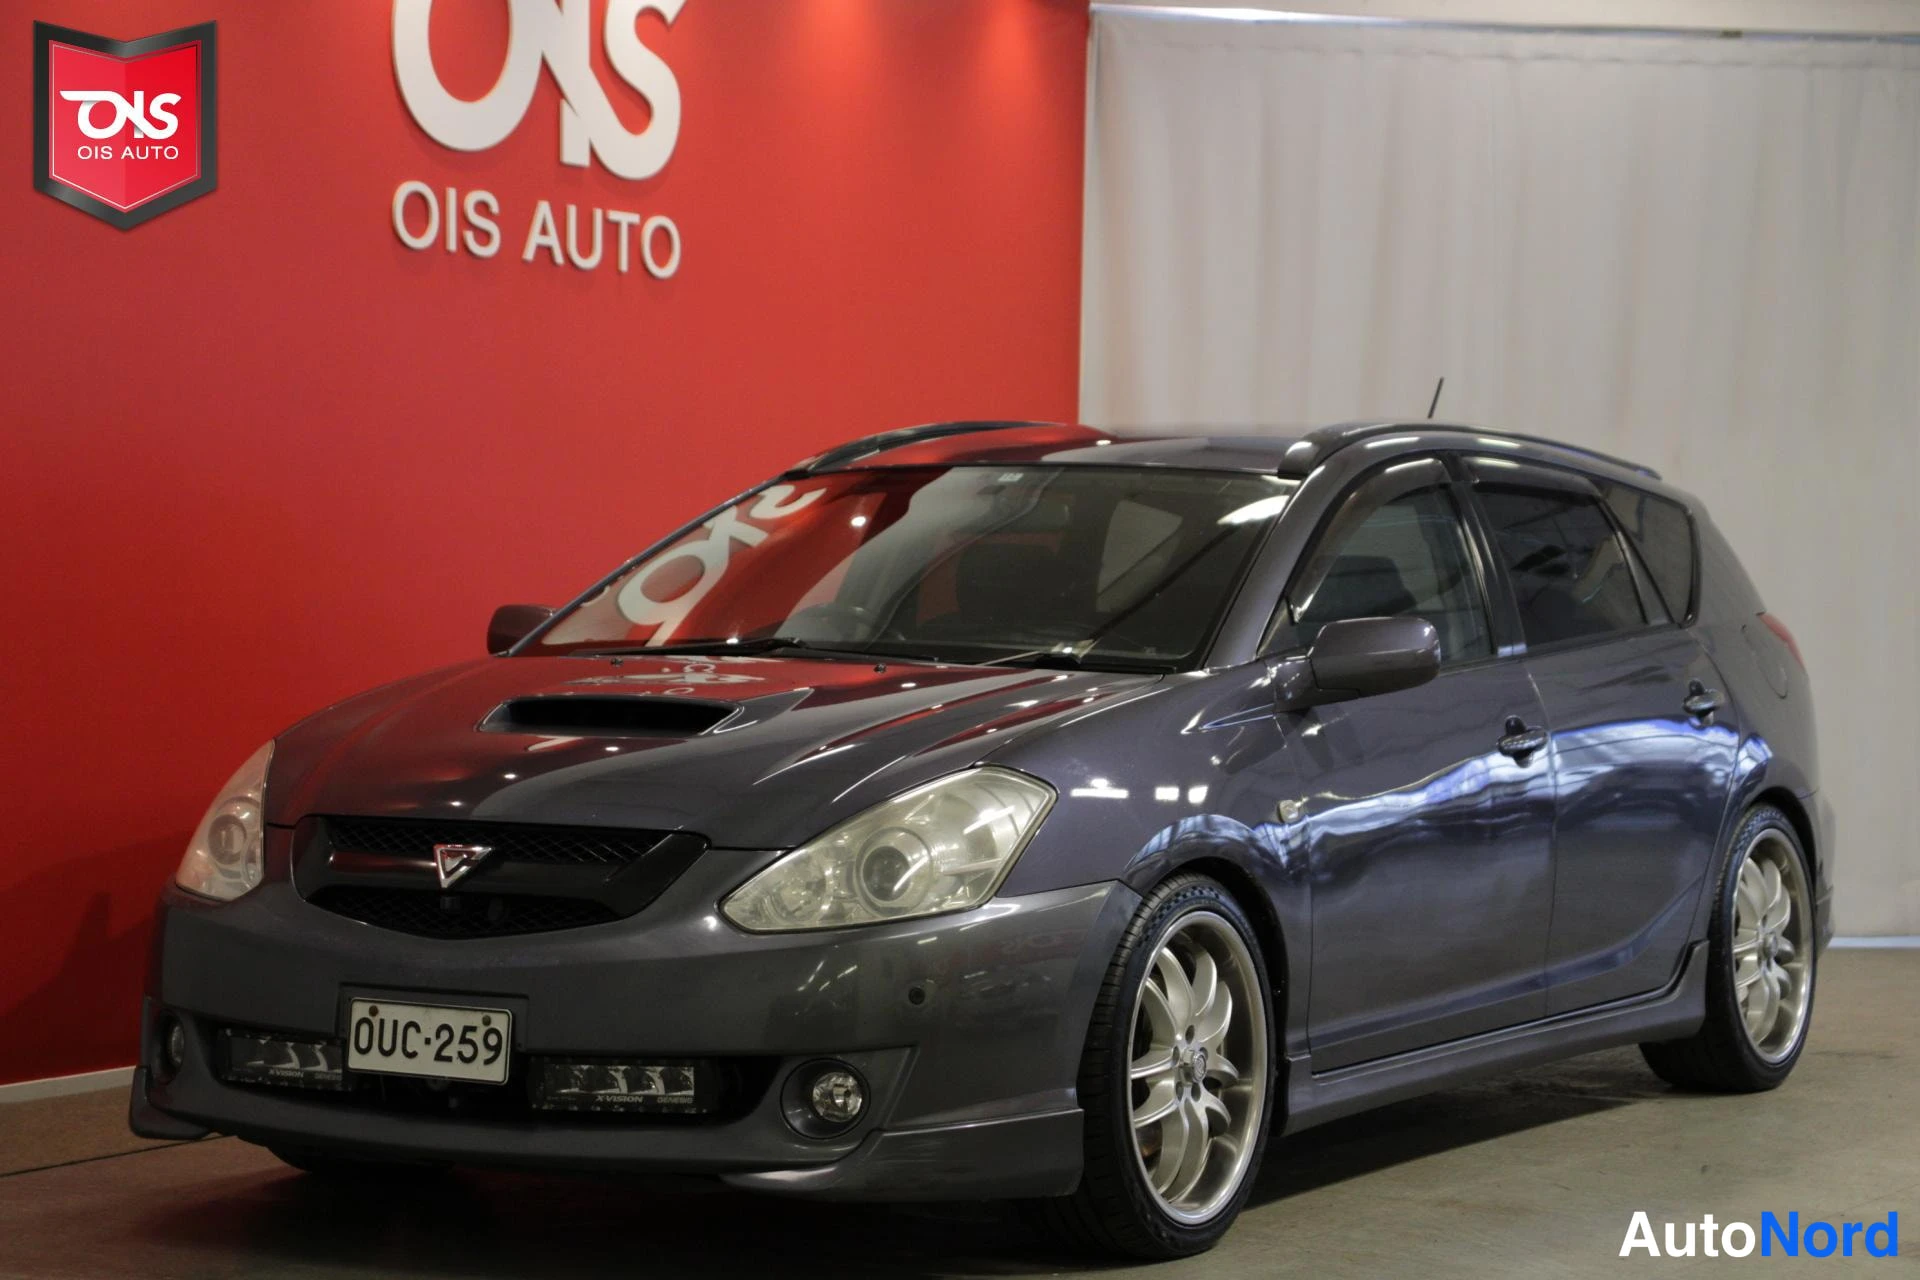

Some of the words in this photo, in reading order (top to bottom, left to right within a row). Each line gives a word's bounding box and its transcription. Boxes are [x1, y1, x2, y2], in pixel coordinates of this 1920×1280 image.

[392, 0, 686, 180] OIS
[392, 180, 501, 258] OIS
[522, 199, 681, 279] AUTO
[354, 1016, 503, 1066] OUC-259
